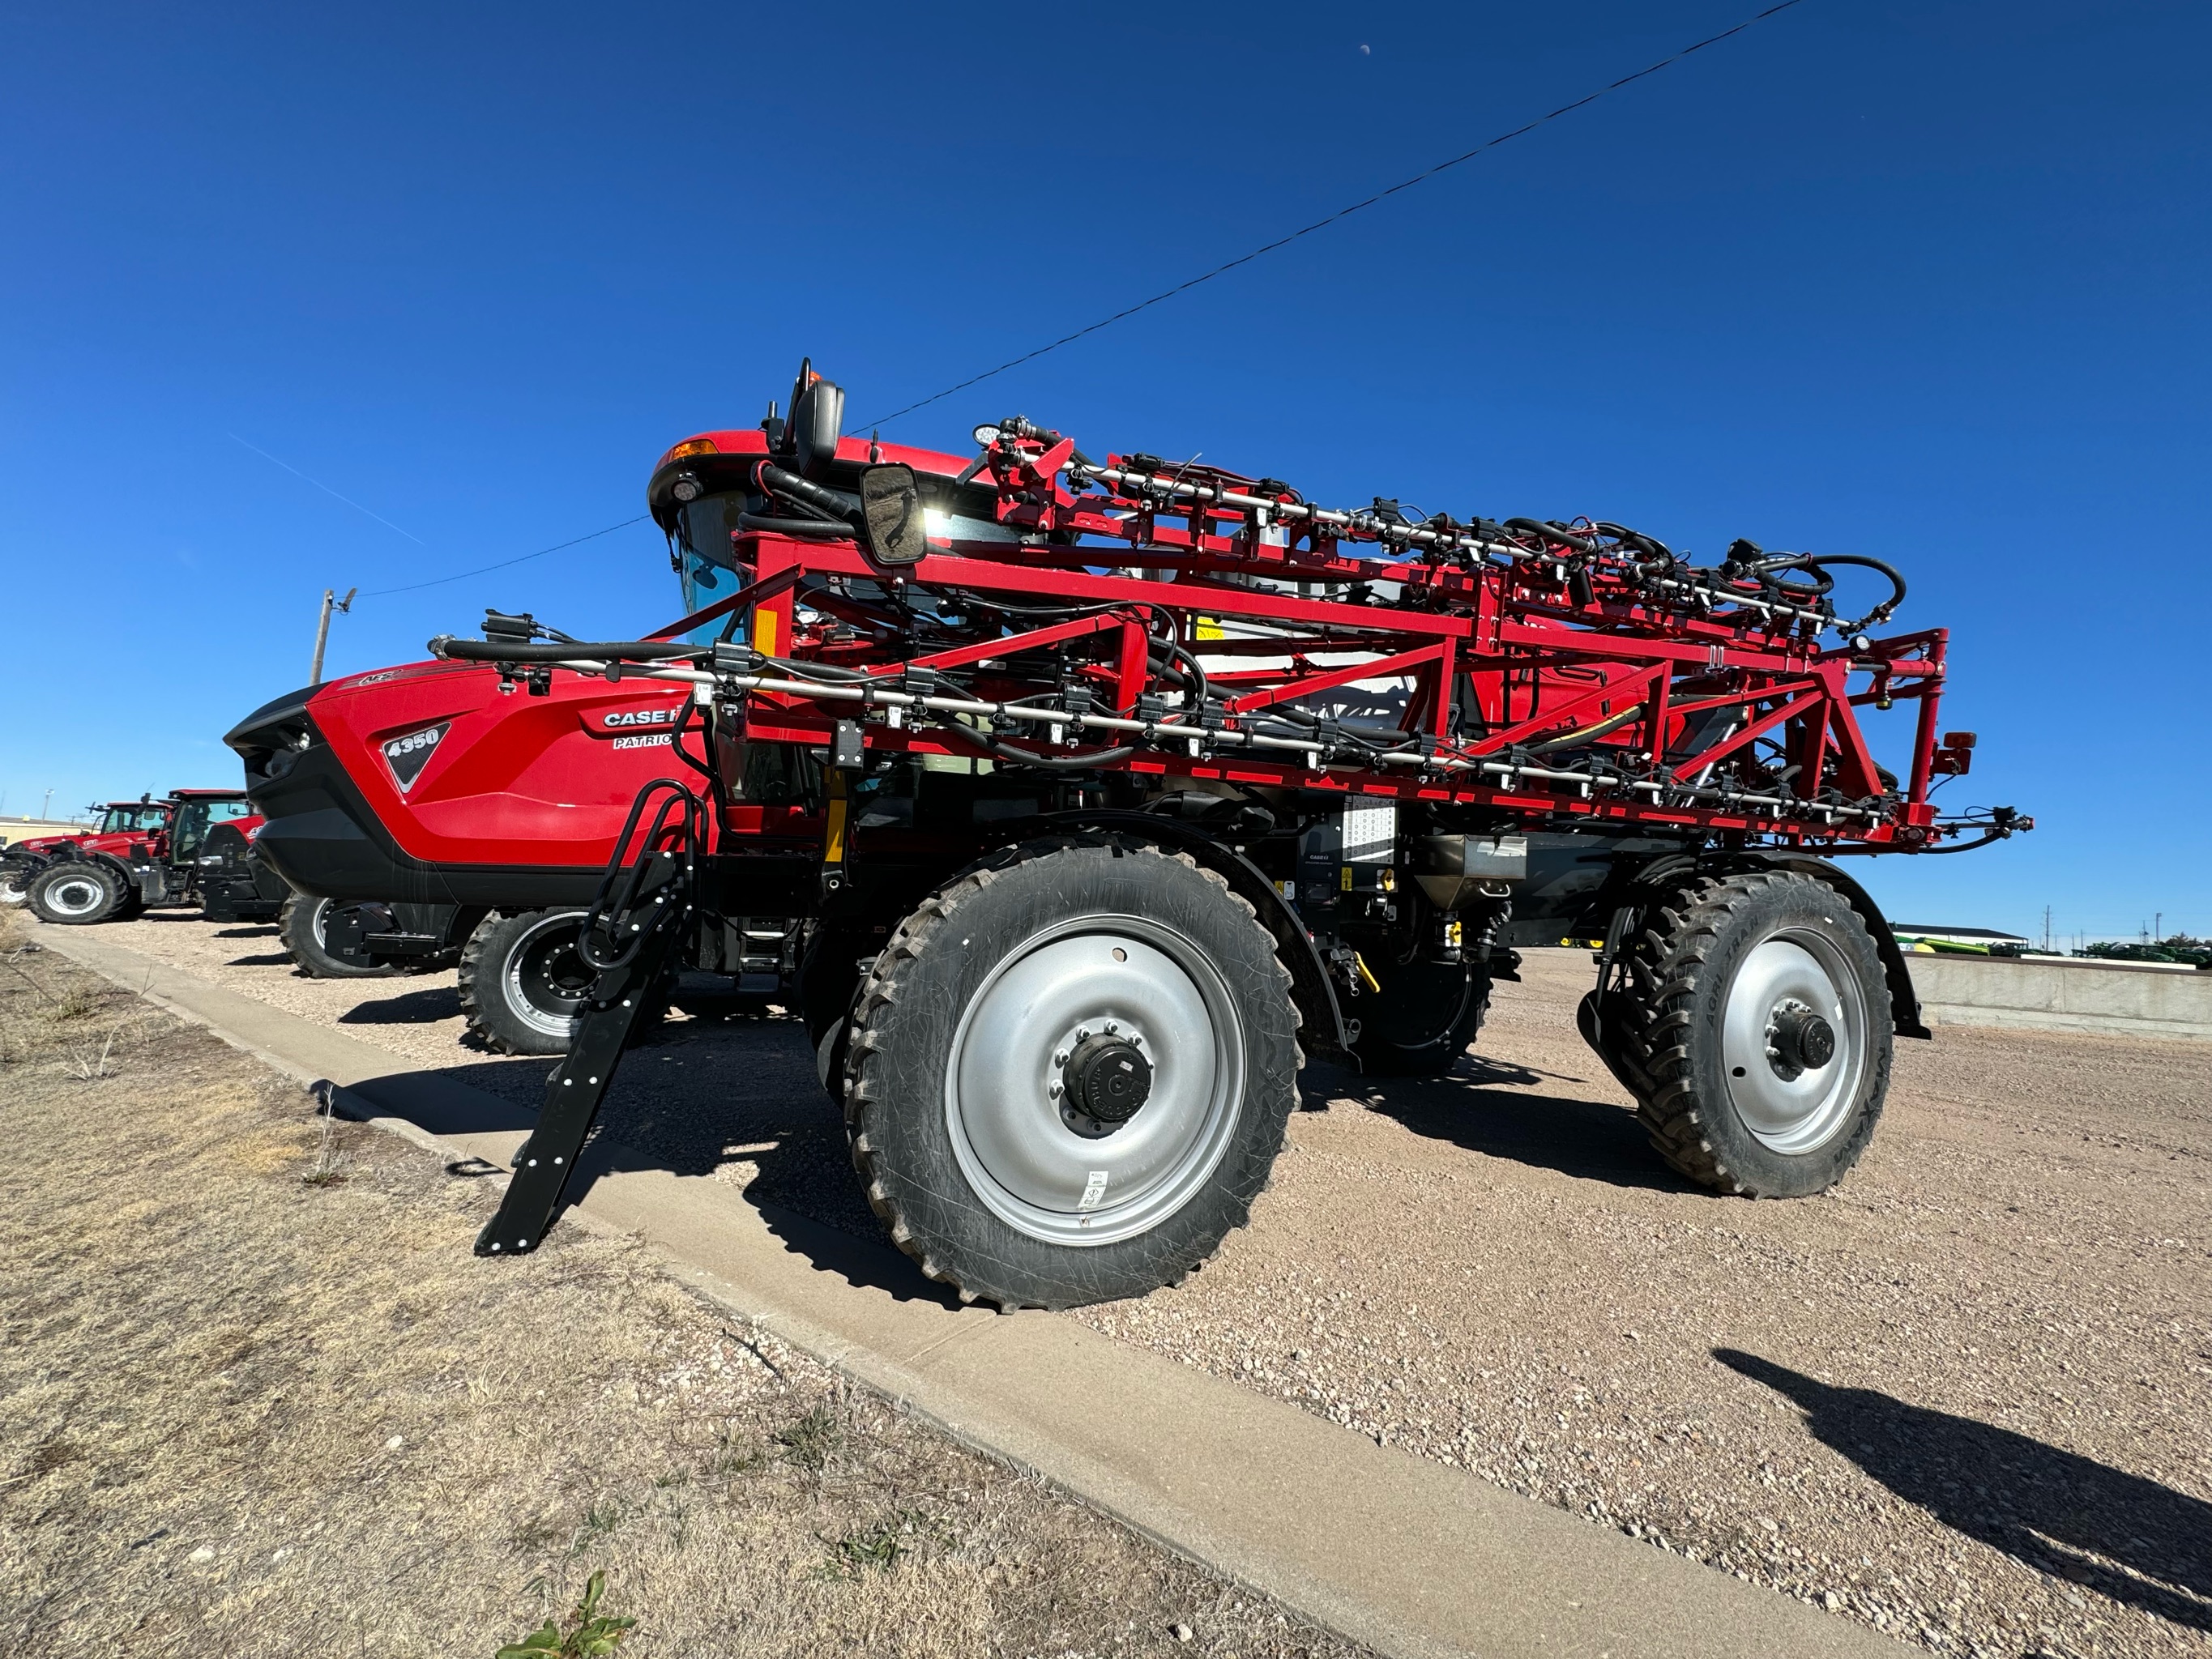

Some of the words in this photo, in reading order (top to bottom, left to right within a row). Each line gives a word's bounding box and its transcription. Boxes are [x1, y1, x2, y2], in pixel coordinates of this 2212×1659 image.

[359, 672, 395, 686] AFS
[604, 711, 666, 726] CASE
[388, 728, 439, 757] 4350
[614, 732, 684, 749] PATRIO
[1706, 973, 1723, 1028] AGRI
[1834, 1046, 1886, 1164] MAXAM
